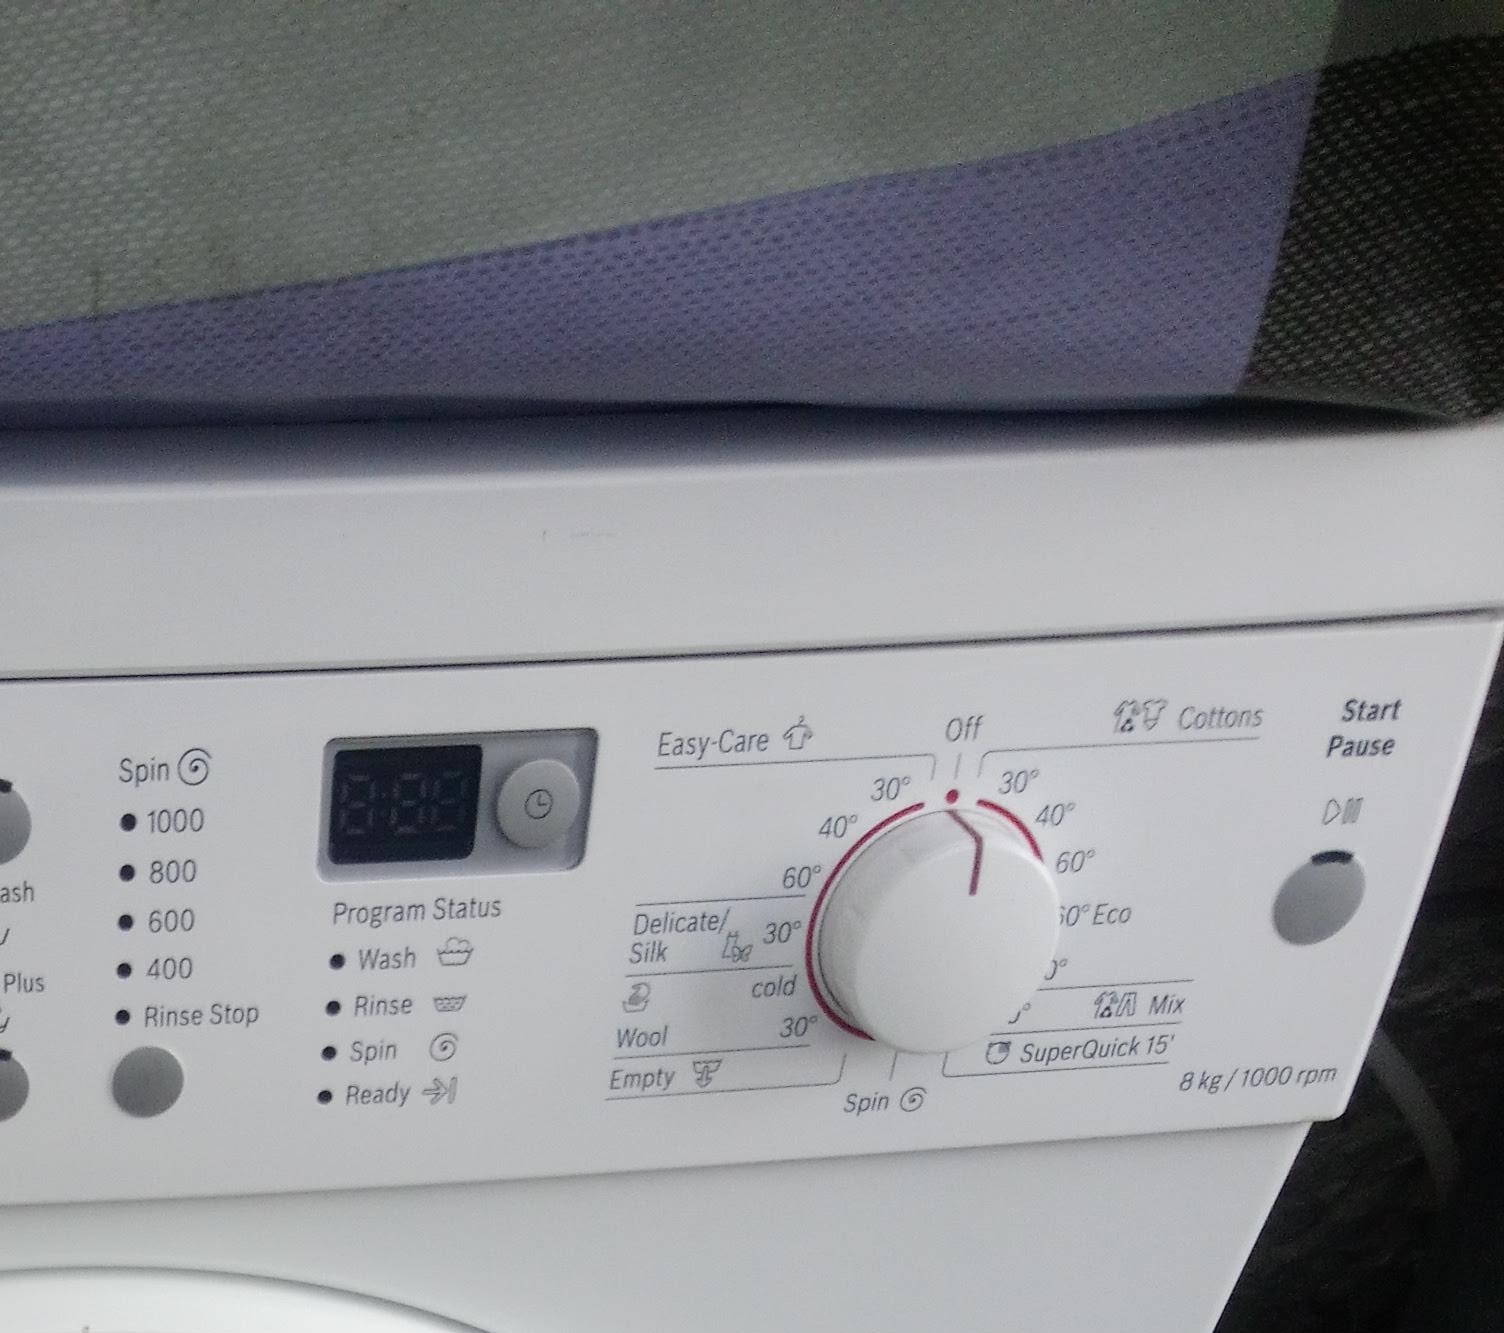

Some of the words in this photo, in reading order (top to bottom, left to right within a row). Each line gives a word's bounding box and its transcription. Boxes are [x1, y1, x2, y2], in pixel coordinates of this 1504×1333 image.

[1178, 706, 1264, 731] Cottons
[1342, 699, 1403, 724] Start
[946, 715, 984, 742] Off
[657, 728, 770, 760] Easy-Care
[1327, 735, 1395, 759] Pause
[119, 757, 170, 787] Spin
[147, 808, 204, 833] 1000
[149, 859, 197, 884] 800
[148, 909, 195, 932] 600
[333, 901, 426, 929] Program
[433, 897, 502, 921] Status
[633, 908, 730, 935] Delicate/
[1092, 904, 1132, 926] Eco
[359, 946, 416, 970] Wash
[629, 943, 667, 964] Silk
[146, 957, 193, 980] 400
[4, 973, 45, 993] Plus
[752, 975, 797, 999] cold
[144, 1005, 203, 1027] Rinse
[209, 1002, 260, 1027] Stop
[354, 995, 413, 1017] Rinse
[1148, 996, 1186, 1016] Mix
[616, 1026, 668, 1049] Wool
[350, 1039, 397, 1065] Spin
[1019, 1038, 1140, 1066] SuperQuick
[609, 1066, 675, 1093] Empty
[1180, 1074, 1195, 1093] 8
[1198, 1071, 1220, 1094] kg
[1242, 1067, 1292, 1087] 1000
[1296, 1068, 1337, 1084] rpm
[346, 1082, 411, 1108] Ready
[844, 1092, 890, 1116] Spin
